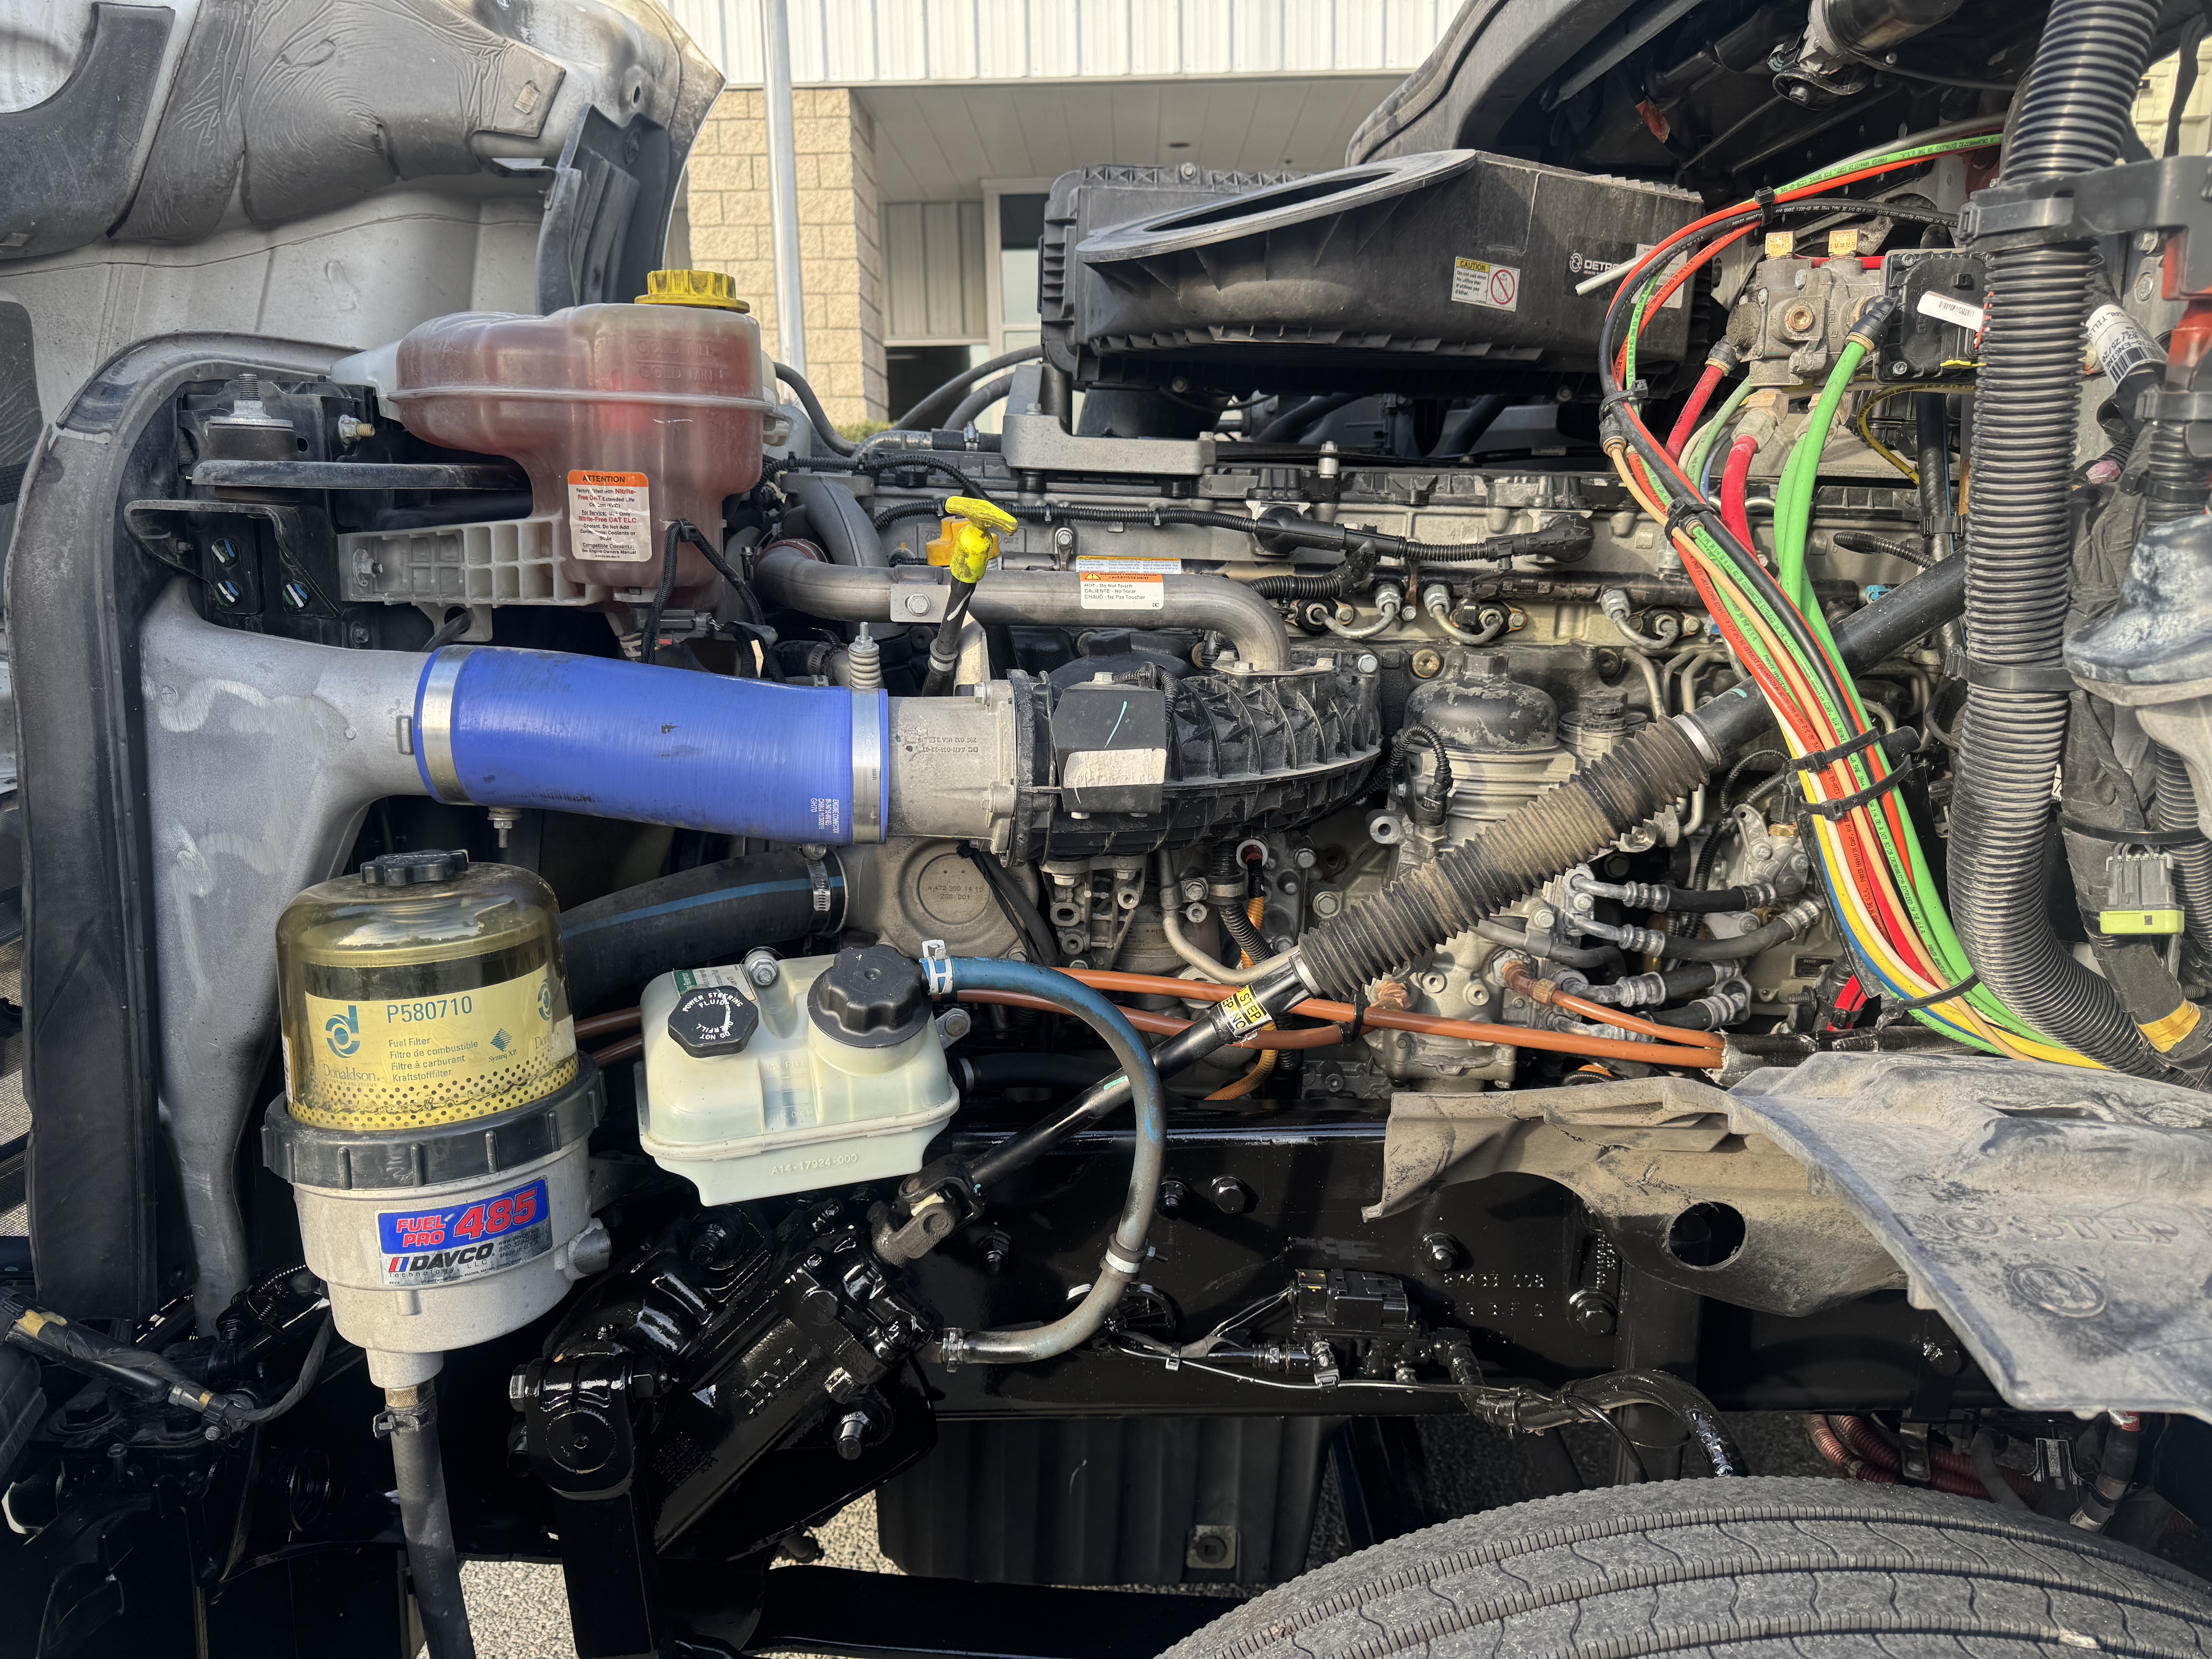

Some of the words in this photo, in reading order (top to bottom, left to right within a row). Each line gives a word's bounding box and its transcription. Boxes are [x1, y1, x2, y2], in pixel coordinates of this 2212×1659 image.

[1460, 261, 1486, 271] CAUTION
[583, 475, 625, 483] ATTENTION
[386, 996, 472, 1024] P580710
[682, 994, 704, 1012] POWER
[708, 992, 744, 1008] STEERING
[698, 999, 726, 1008] FLUID
[1240, 993, 1262, 1019] STEP
[388, 1039, 406, 1048] Fuel
[409, 1037, 431, 1046] Filter
[390, 1051, 411, 1060] Filtro
[414, 1049, 424, 1057] de
[427, 1041, 478, 1056] combustible
[391, 1062, 412, 1071] Filtre
[415, 1060, 421, 1069] à
[422, 1054, 466, 1068] carburant
[488, 1053, 508, 1063] Synteq
[392, 1068, 452, 1082] Kraftstofffilter
[771, 1153, 858, 1175] A14-17924-000
[396, 1214, 446, 1233] FUEL
[453, 1186, 538, 1240] 485
[1892, 1212, 1999, 1240] NO
[2011, 1214, 2180, 1244] STEP
[403, 1230, 445, 1248] PRO
[409, 1242, 494, 1271] DAVCO
